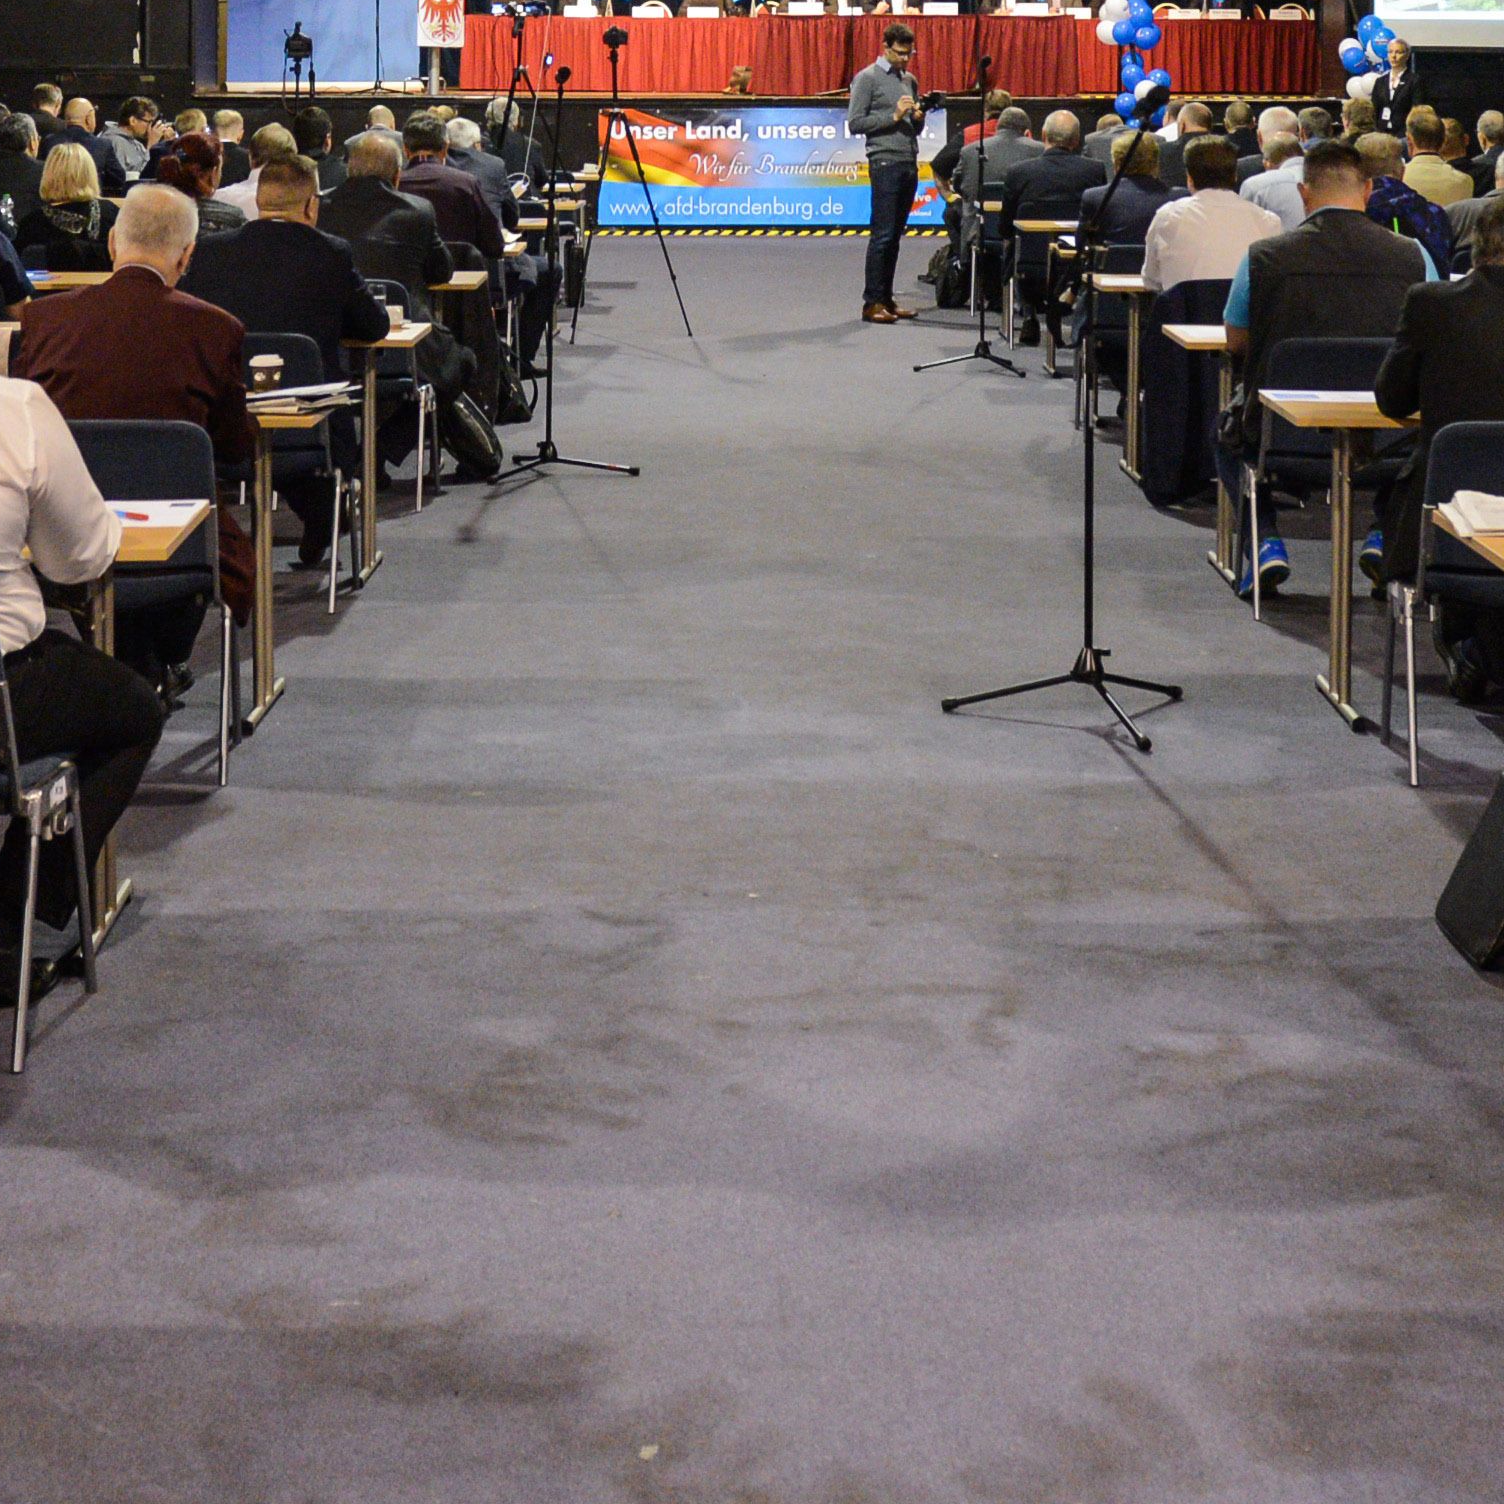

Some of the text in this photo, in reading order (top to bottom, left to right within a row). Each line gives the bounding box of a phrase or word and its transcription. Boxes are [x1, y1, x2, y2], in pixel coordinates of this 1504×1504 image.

[610, 120, 678, 140] Unser
[685, 120, 748, 143] Land,
[757, 124, 836, 140] unsere
[689, 151, 858, 181] Wir für Brandenburg
[610, 195, 844, 220] www.afd-brandenburg.de
